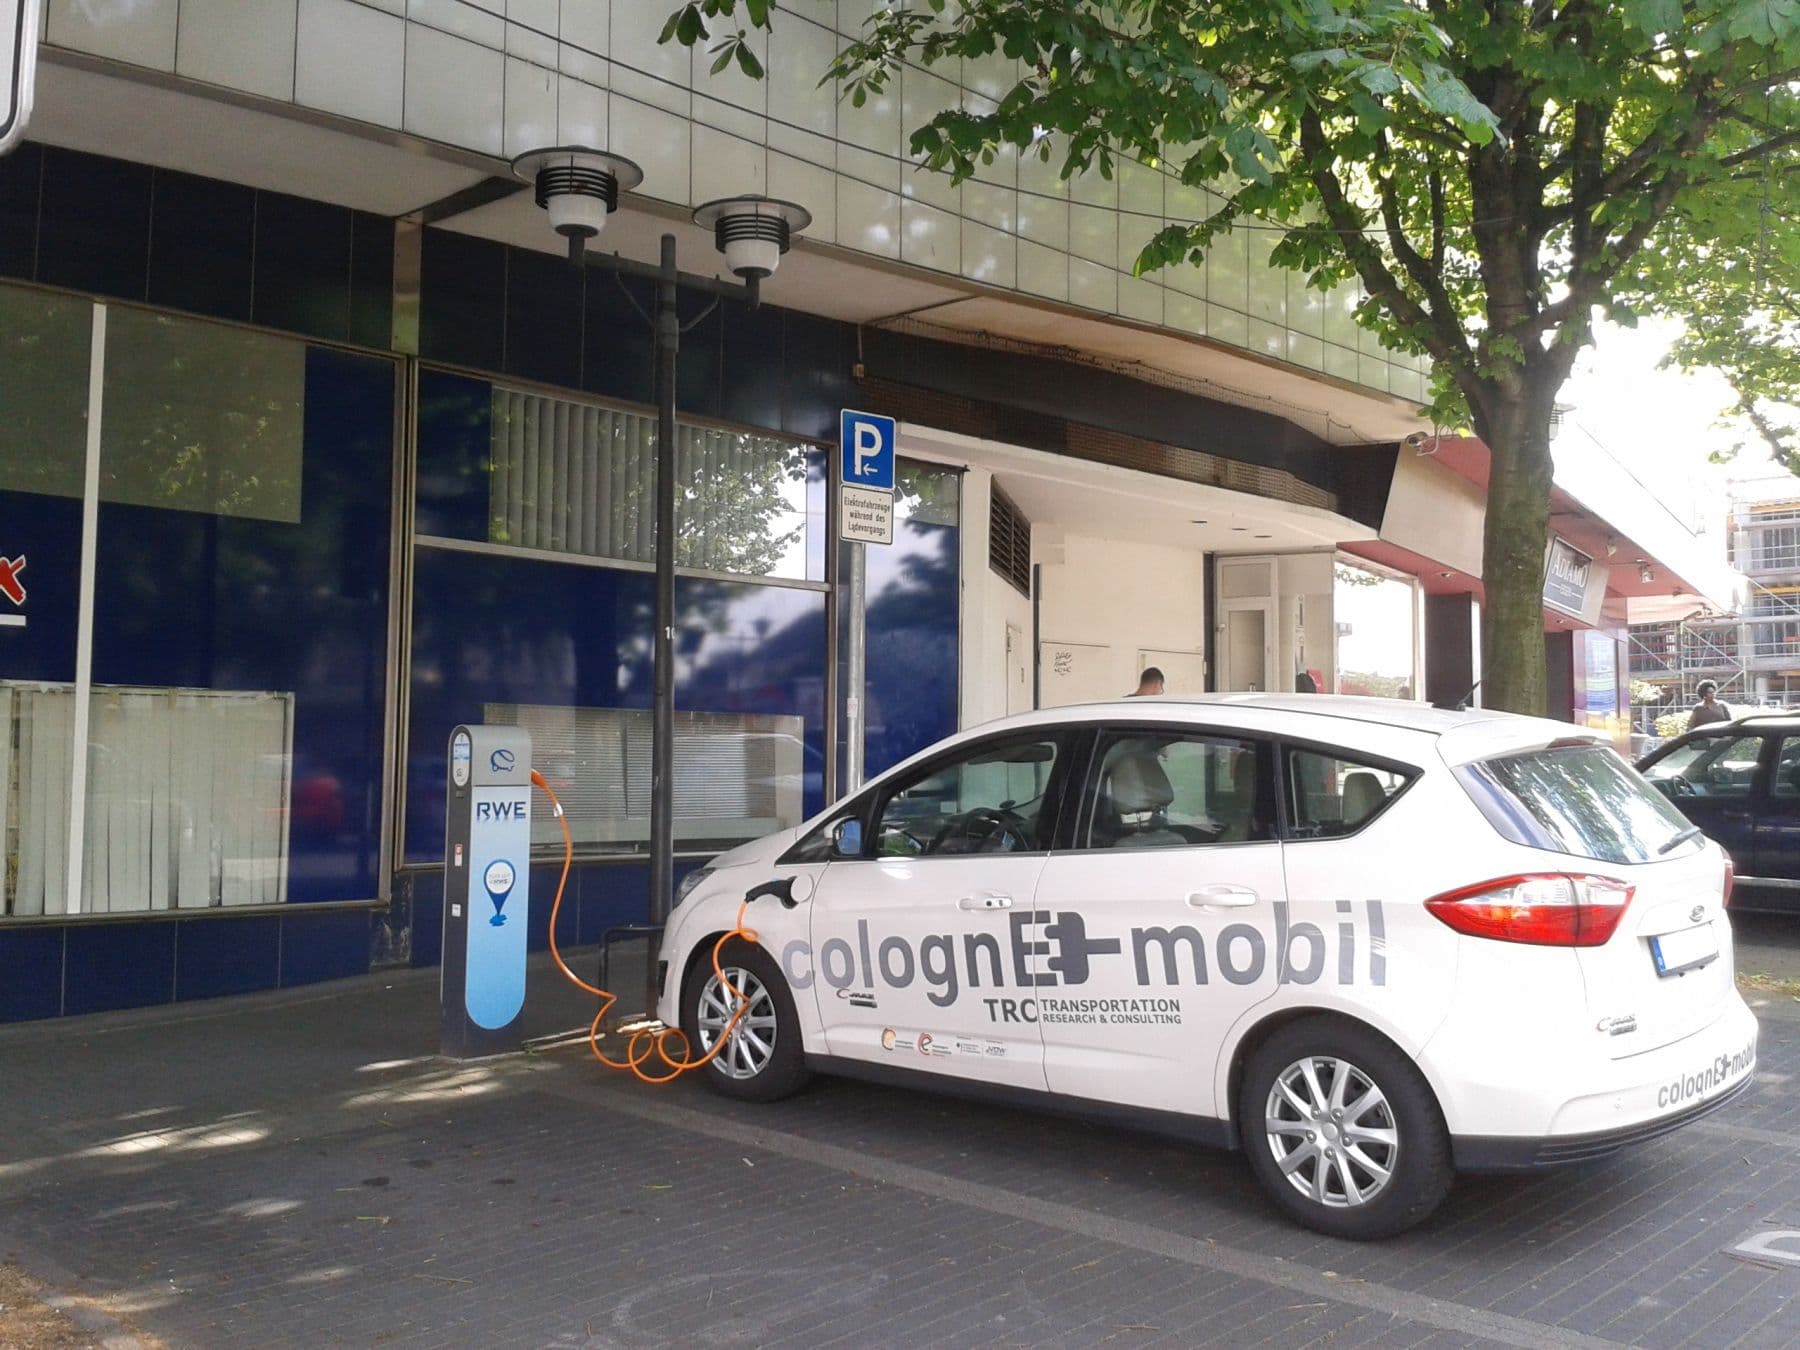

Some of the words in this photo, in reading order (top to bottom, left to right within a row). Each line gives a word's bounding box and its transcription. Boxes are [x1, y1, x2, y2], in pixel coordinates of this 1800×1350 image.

[854, 421, 882, 475] P
[844, 496, 890, 513] Elektrofahrzeuge
[849, 510, 873, 521] während
[876, 513, 886, 523] des
[848, 521, 886, 536] Ladevorgangs
[1551, 552, 1588, 588] ADIAMO
[477, 802, 526, 818] RWE
[983, 999, 1038, 1023] TRC
[1041, 999, 1181, 1013] TRANSPORTATION
[1042, 1013, 1097, 1024] RESEARCH
[1100, 1014, 1107, 1024] &
[1110, 1014, 1182, 1025] CONSULTING
